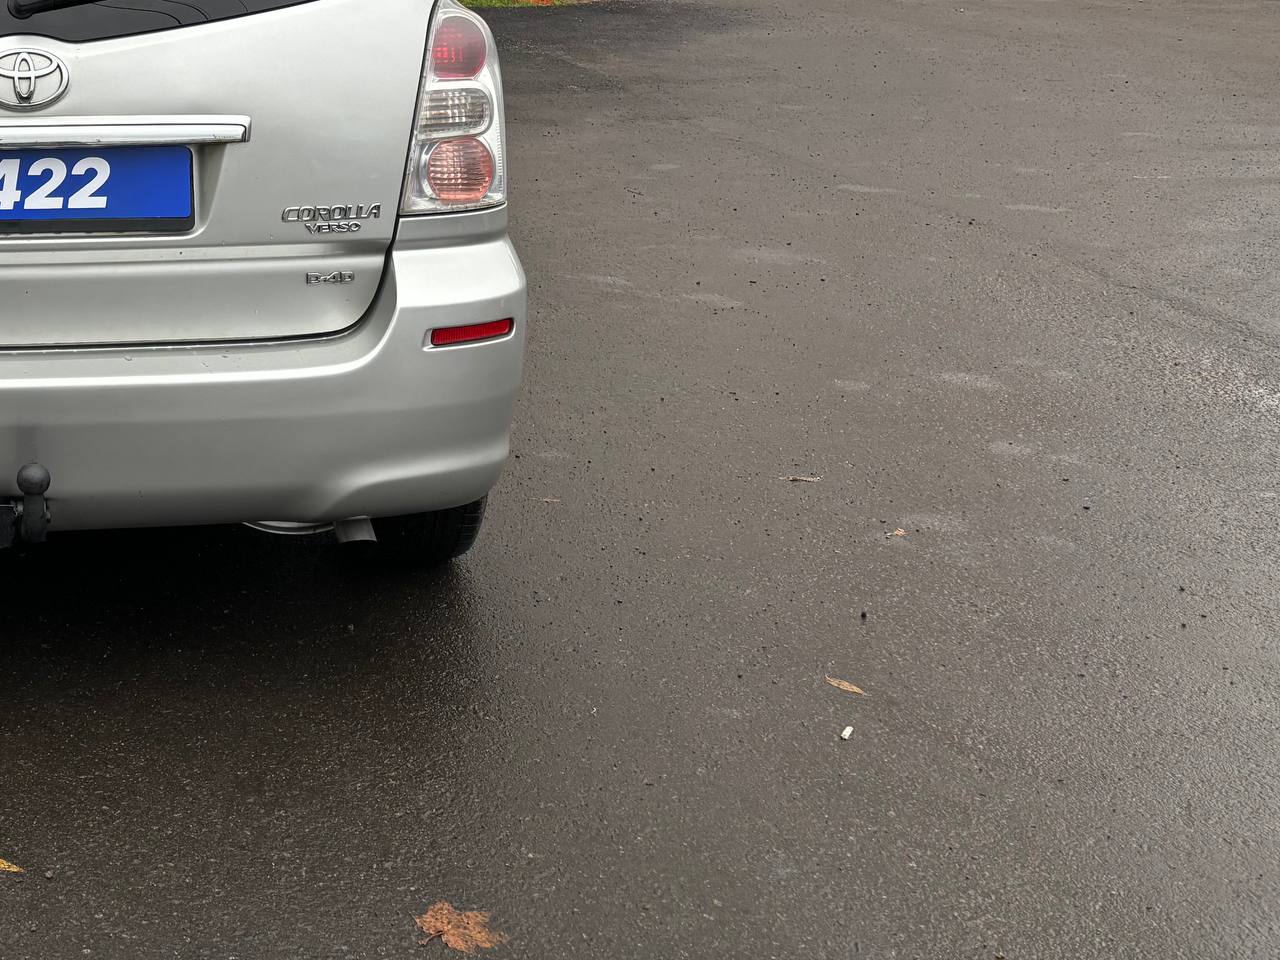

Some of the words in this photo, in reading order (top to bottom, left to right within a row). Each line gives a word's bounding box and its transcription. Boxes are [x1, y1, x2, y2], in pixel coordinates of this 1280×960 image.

[282, 202, 381, 222] COROLLA
[305, 221, 361, 234] VERSO
[306, 271, 354, 284] D-4D
